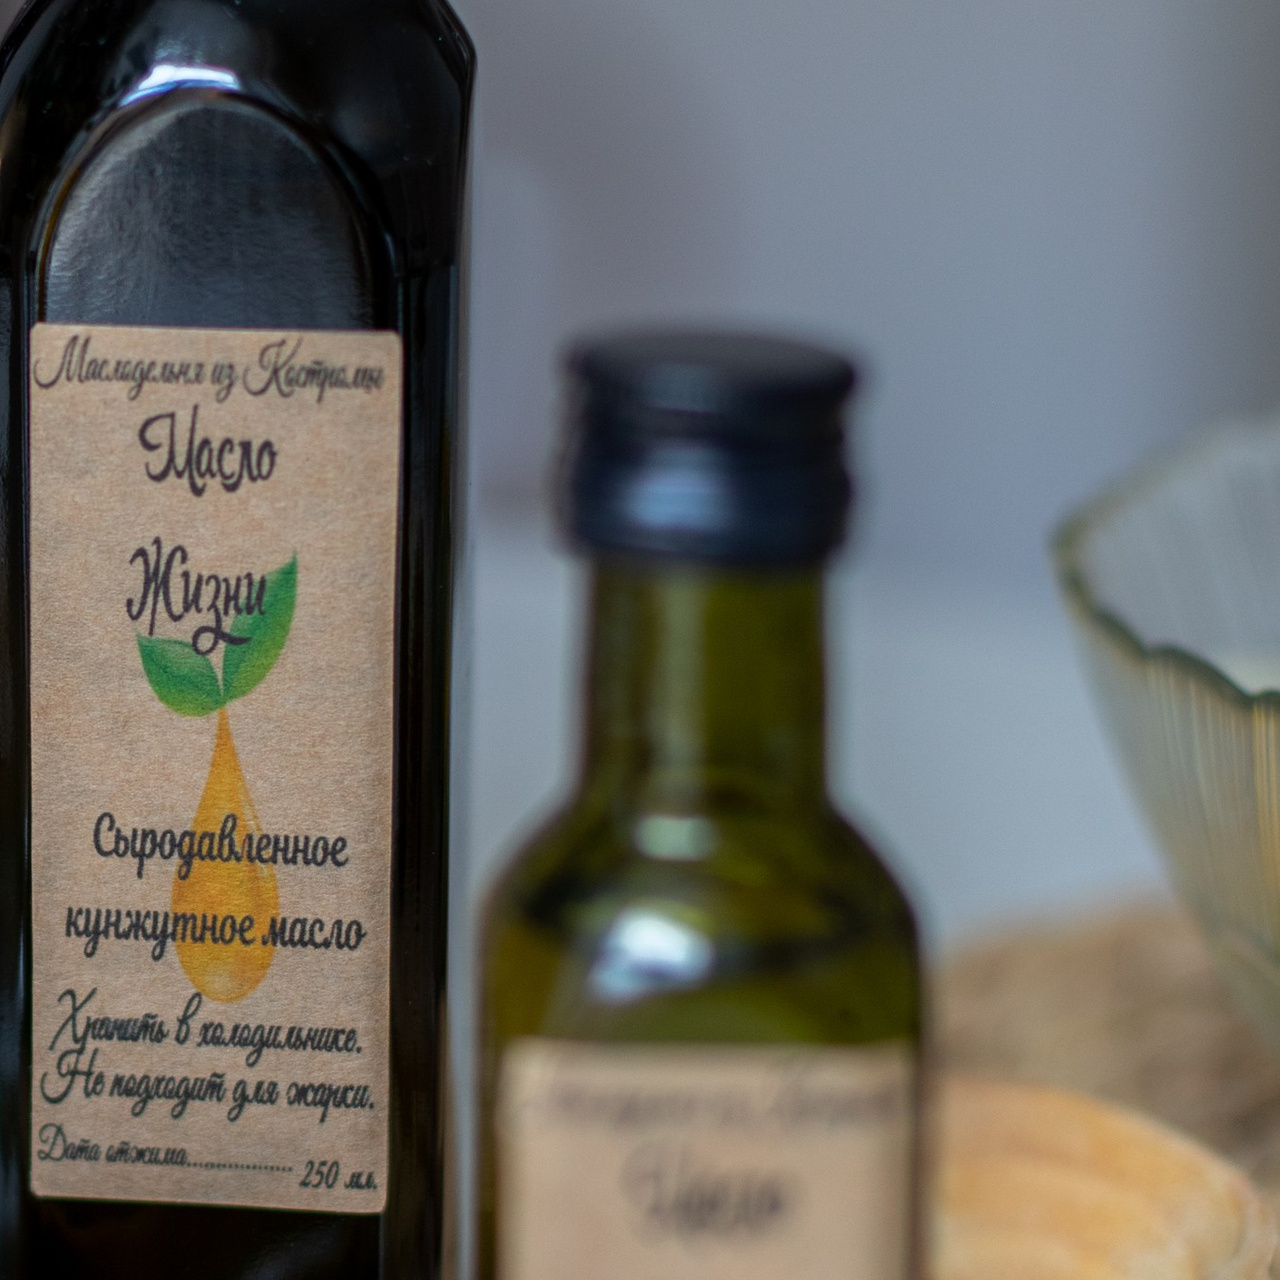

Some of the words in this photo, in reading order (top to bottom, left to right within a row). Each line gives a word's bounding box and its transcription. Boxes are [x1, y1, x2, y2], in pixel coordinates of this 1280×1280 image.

[209, 361, 238, 403] из
[138, 404, 278, 497] Масло
[126, 536, 268, 656] Жизни
[93, 811, 349, 880] Сыродавленное
[65, 906, 260, 961] кунжутное
[261, 917, 367, 951] масло
[49, 987, 169, 1054] Хранить
[175, 991, 203, 1045] в
[196, 1020, 362, 1067] холодильнике.
[39, 1048, 105, 1105] Не
[109, 1072, 226, 1118] подходит
[227, 1081, 279, 1122] для
[286, 1083, 375, 1122] жарки.
[37, 1123, 100, 1162] Дата
[299, 1160, 340, 1190] 250
[344, 1174, 378, 1191] мл.
